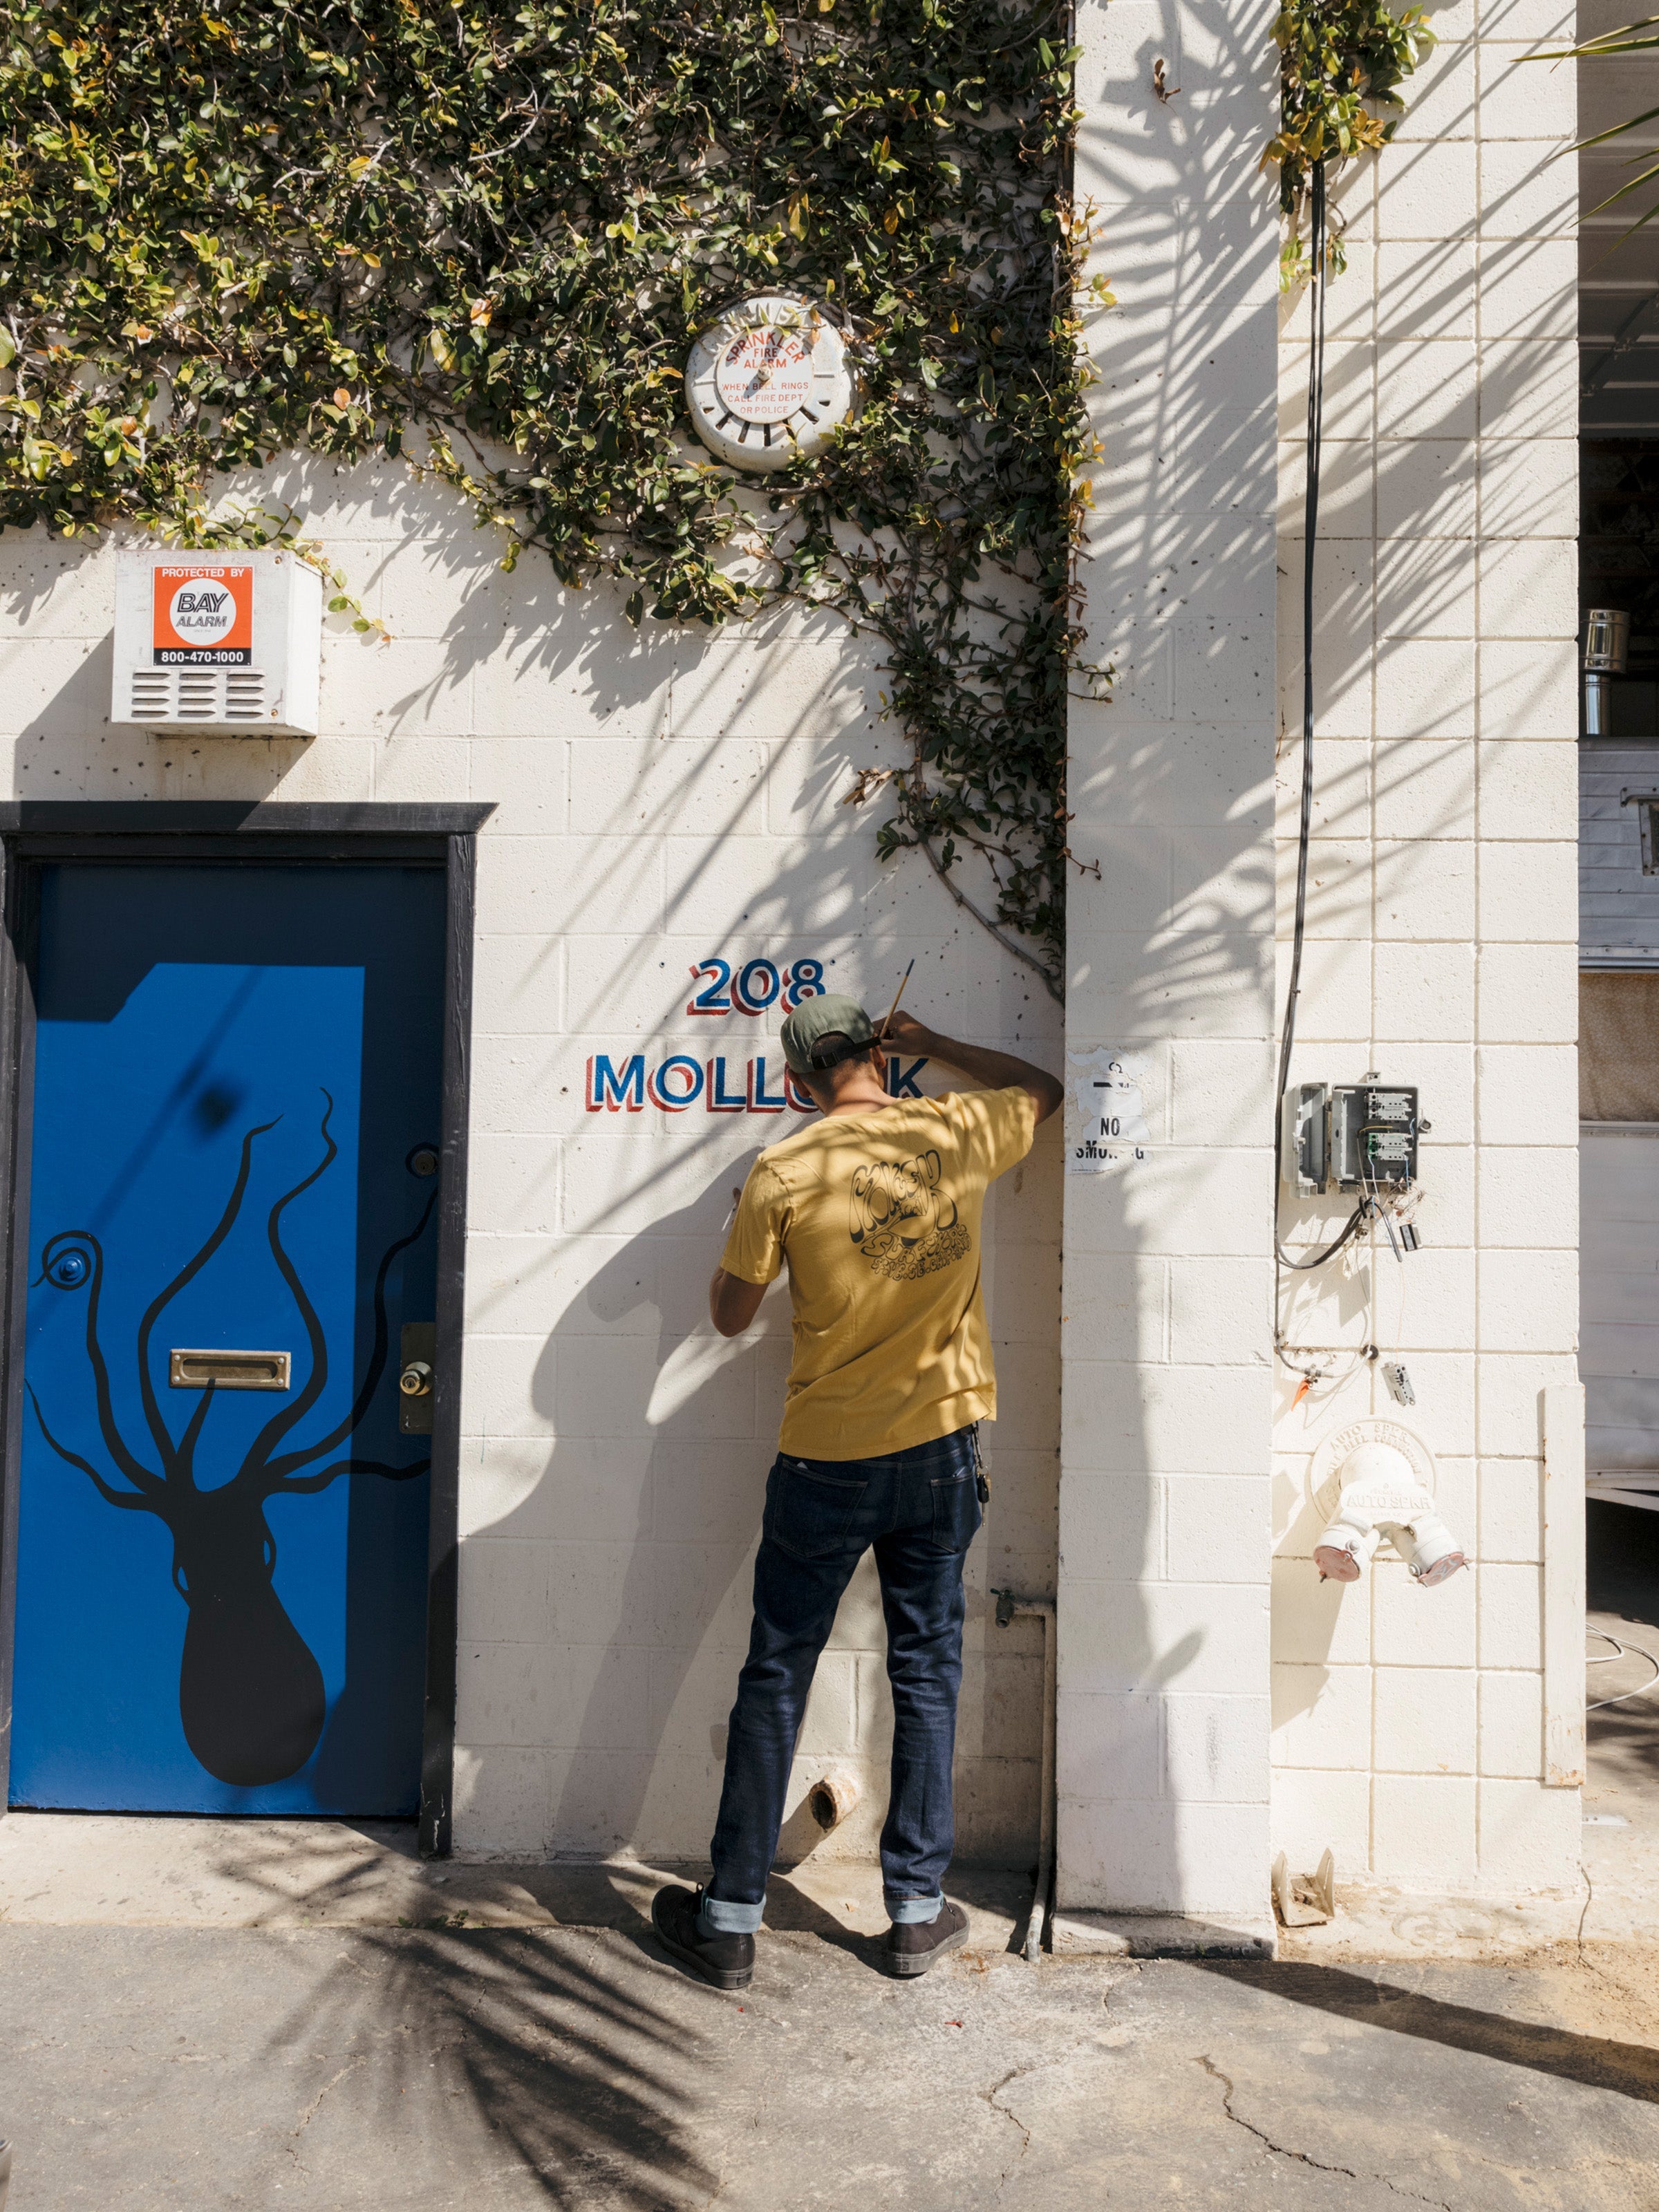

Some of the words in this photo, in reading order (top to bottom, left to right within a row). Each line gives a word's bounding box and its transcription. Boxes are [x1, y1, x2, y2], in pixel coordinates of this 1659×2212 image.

[726, 331, 805, 365] SPRINKLER
[753, 348, 778, 357] FIRE
[162, 568, 225, 578] PROTECTED
[230, 568, 245, 578] BY
[177, 592, 229, 613] BAY
[176, 615, 227, 628] ALARM
[161, 651, 244, 663] 800-470-1000
[686, 958, 826, 1016] 208
[585, 1055, 930, 1114] MOLLK
[1100, 1117, 1120, 1136] NO
[1329, 1425, 1361, 1452] AUTO
